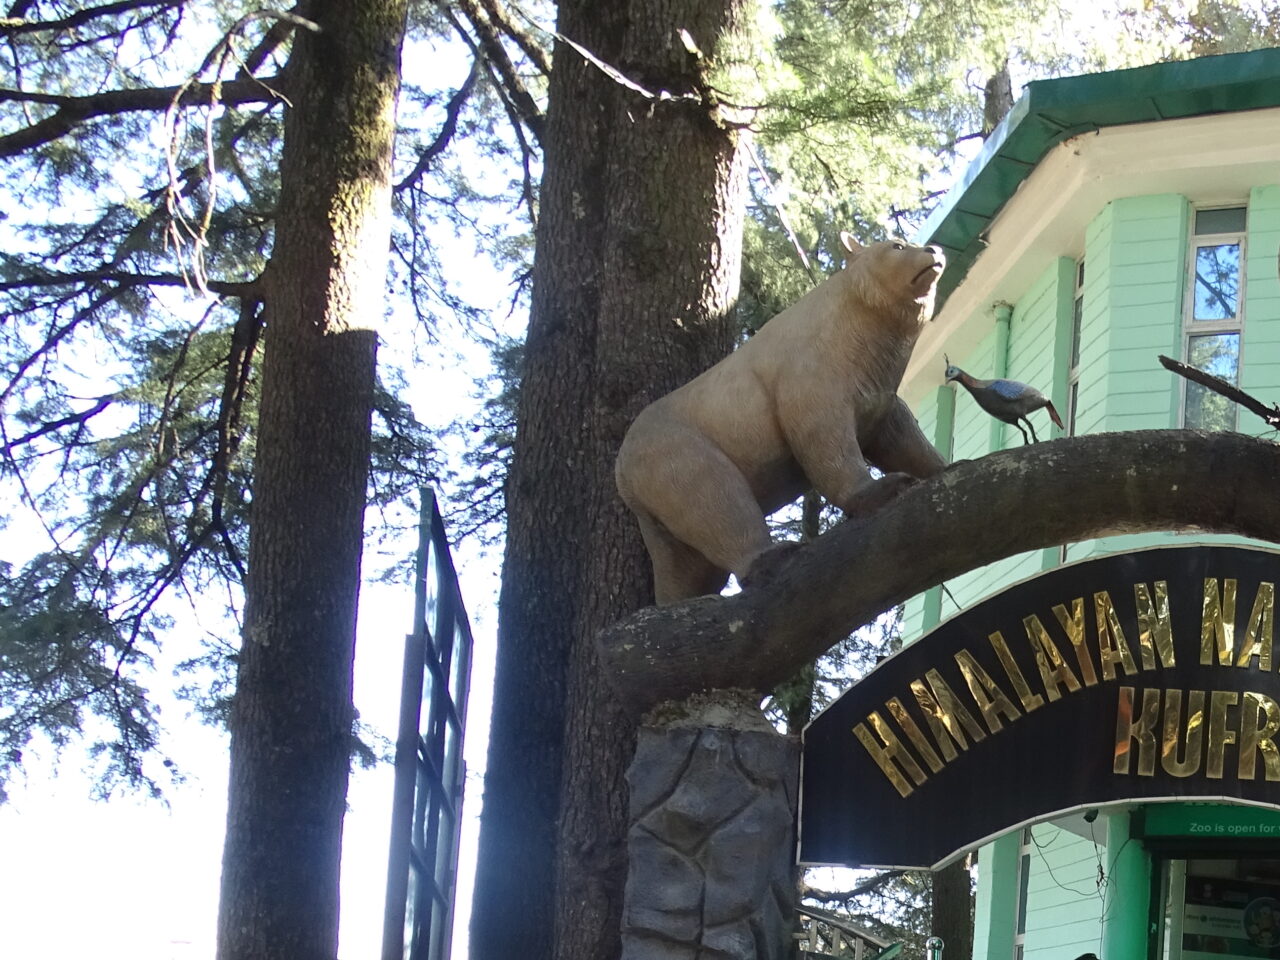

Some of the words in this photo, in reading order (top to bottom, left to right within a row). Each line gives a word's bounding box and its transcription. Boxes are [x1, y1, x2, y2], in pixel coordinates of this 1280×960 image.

[852, 581, 1176, 798] HIMALAYAN
[1190, 822, 1212, 833] Zoo
[1215, 822, 1225, 833] is
[1228, 825, 1256, 835] open
[1259, 823, 1275, 833] for
